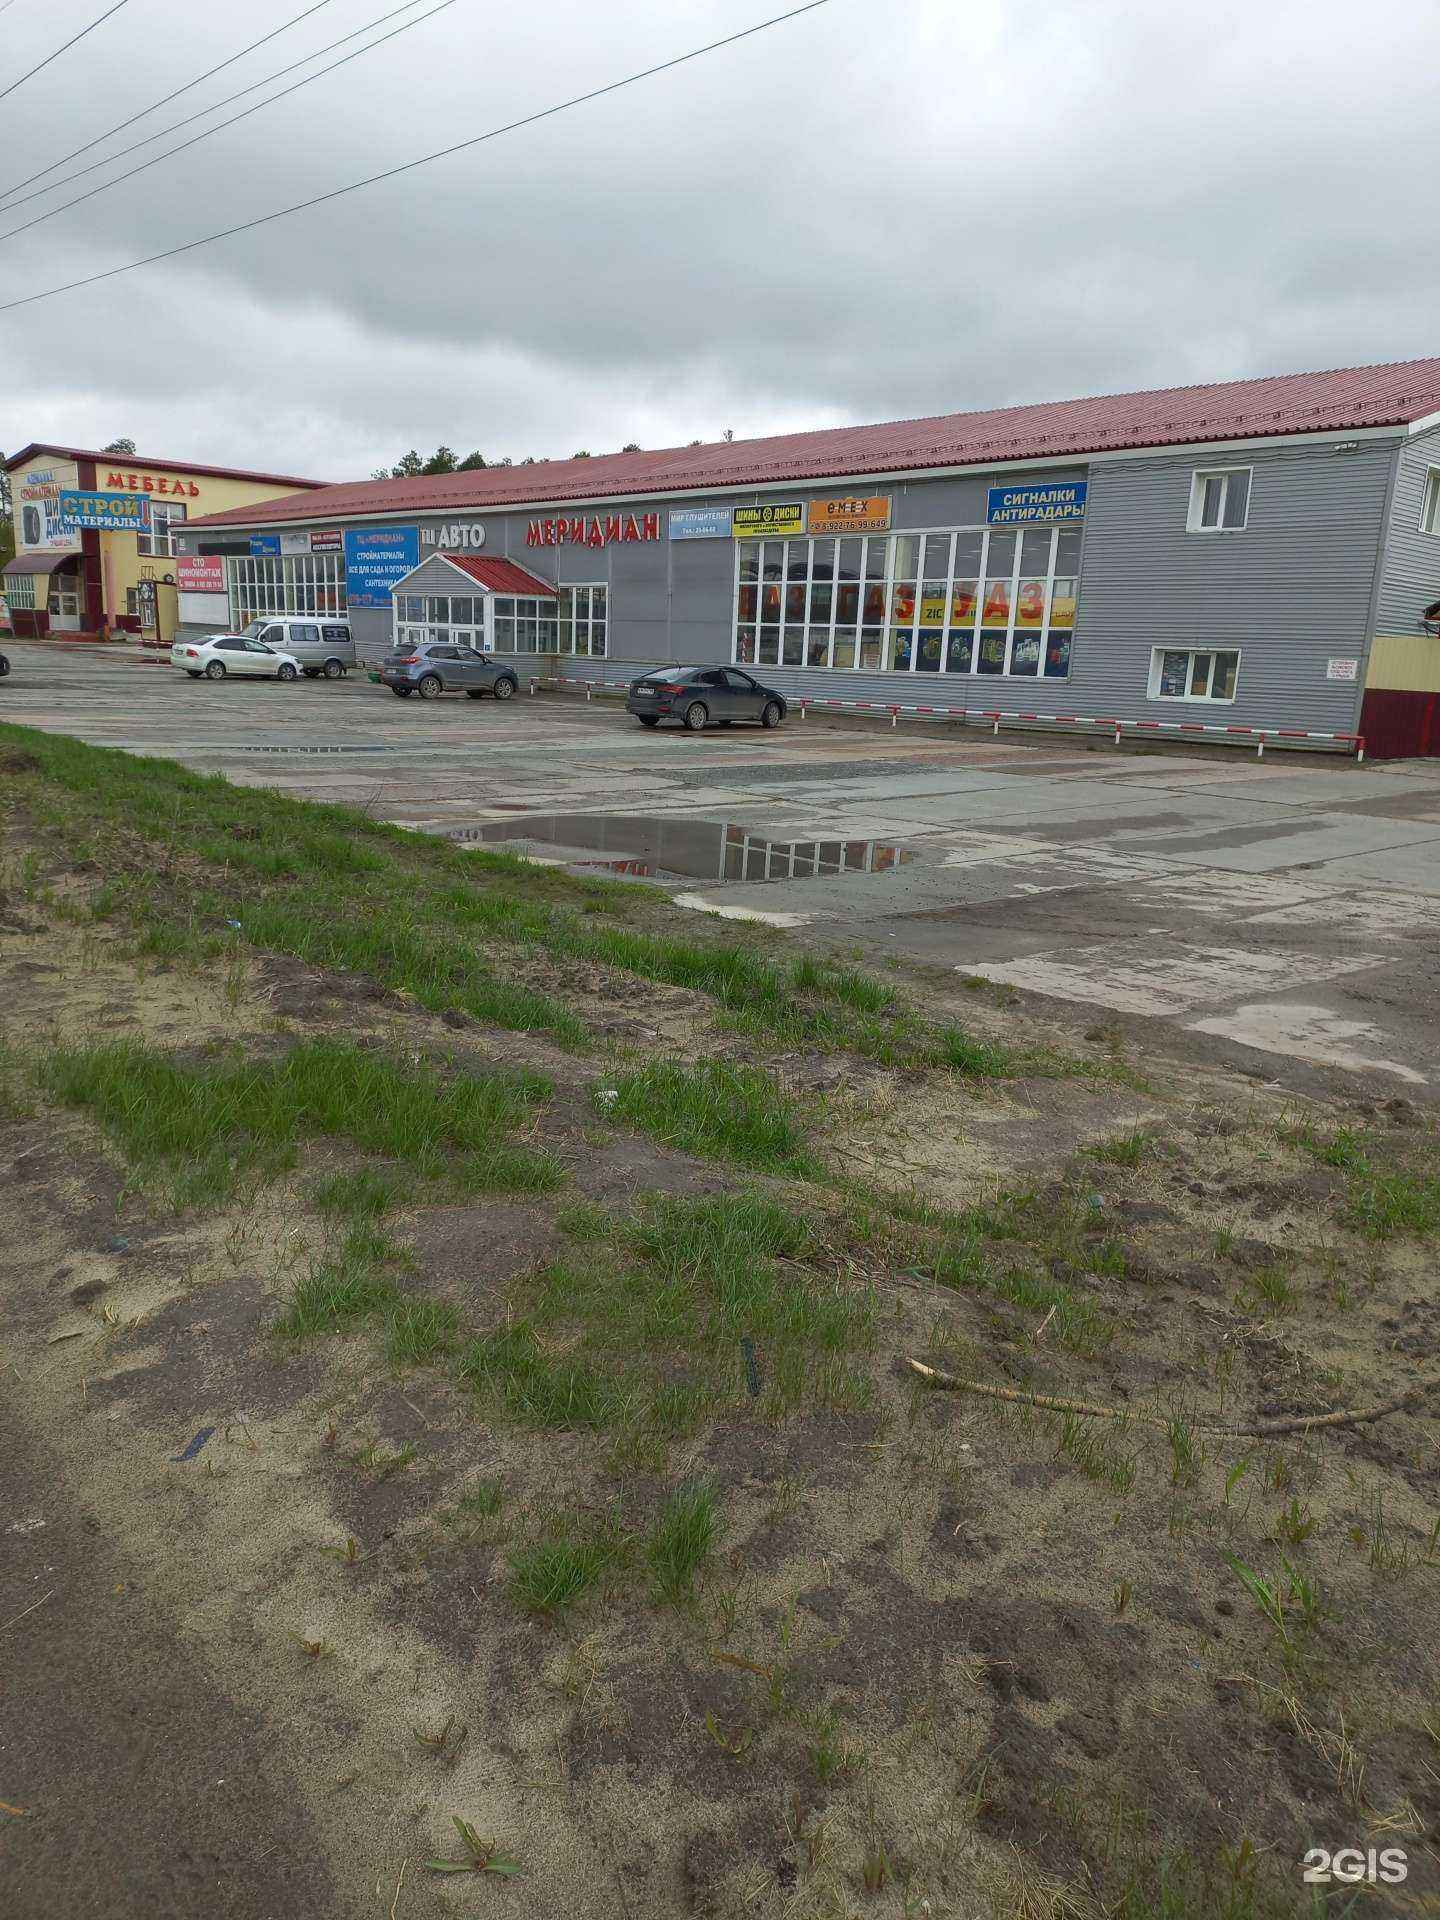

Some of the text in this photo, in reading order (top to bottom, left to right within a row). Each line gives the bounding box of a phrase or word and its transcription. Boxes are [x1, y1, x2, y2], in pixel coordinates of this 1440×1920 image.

[106, 472, 200, 497] МЕБЕЛЬ
[1003, 488, 1076, 505] СИГНАЛКИ
[64, 496, 139, 516] СТРОЙ
[736, 506, 800, 522] ШИНЫ ДИСКИ
[991, 503, 1085, 522] АНТИРАДАРЫ
[63, 514, 141, 528] МАТЕРИАЛЫ
[437, 524, 486, 549] АВТО
[526, 512, 660, 549] МЕРИДИАН
[192, 557, 205, 568] СТО
[356, 550, 405, 560] СТРОЙМАТЕРИАЛЫ
[178, 567, 222, 578] ШИНОМОНТАЖ
[370, 565, 384, 574] САДА
